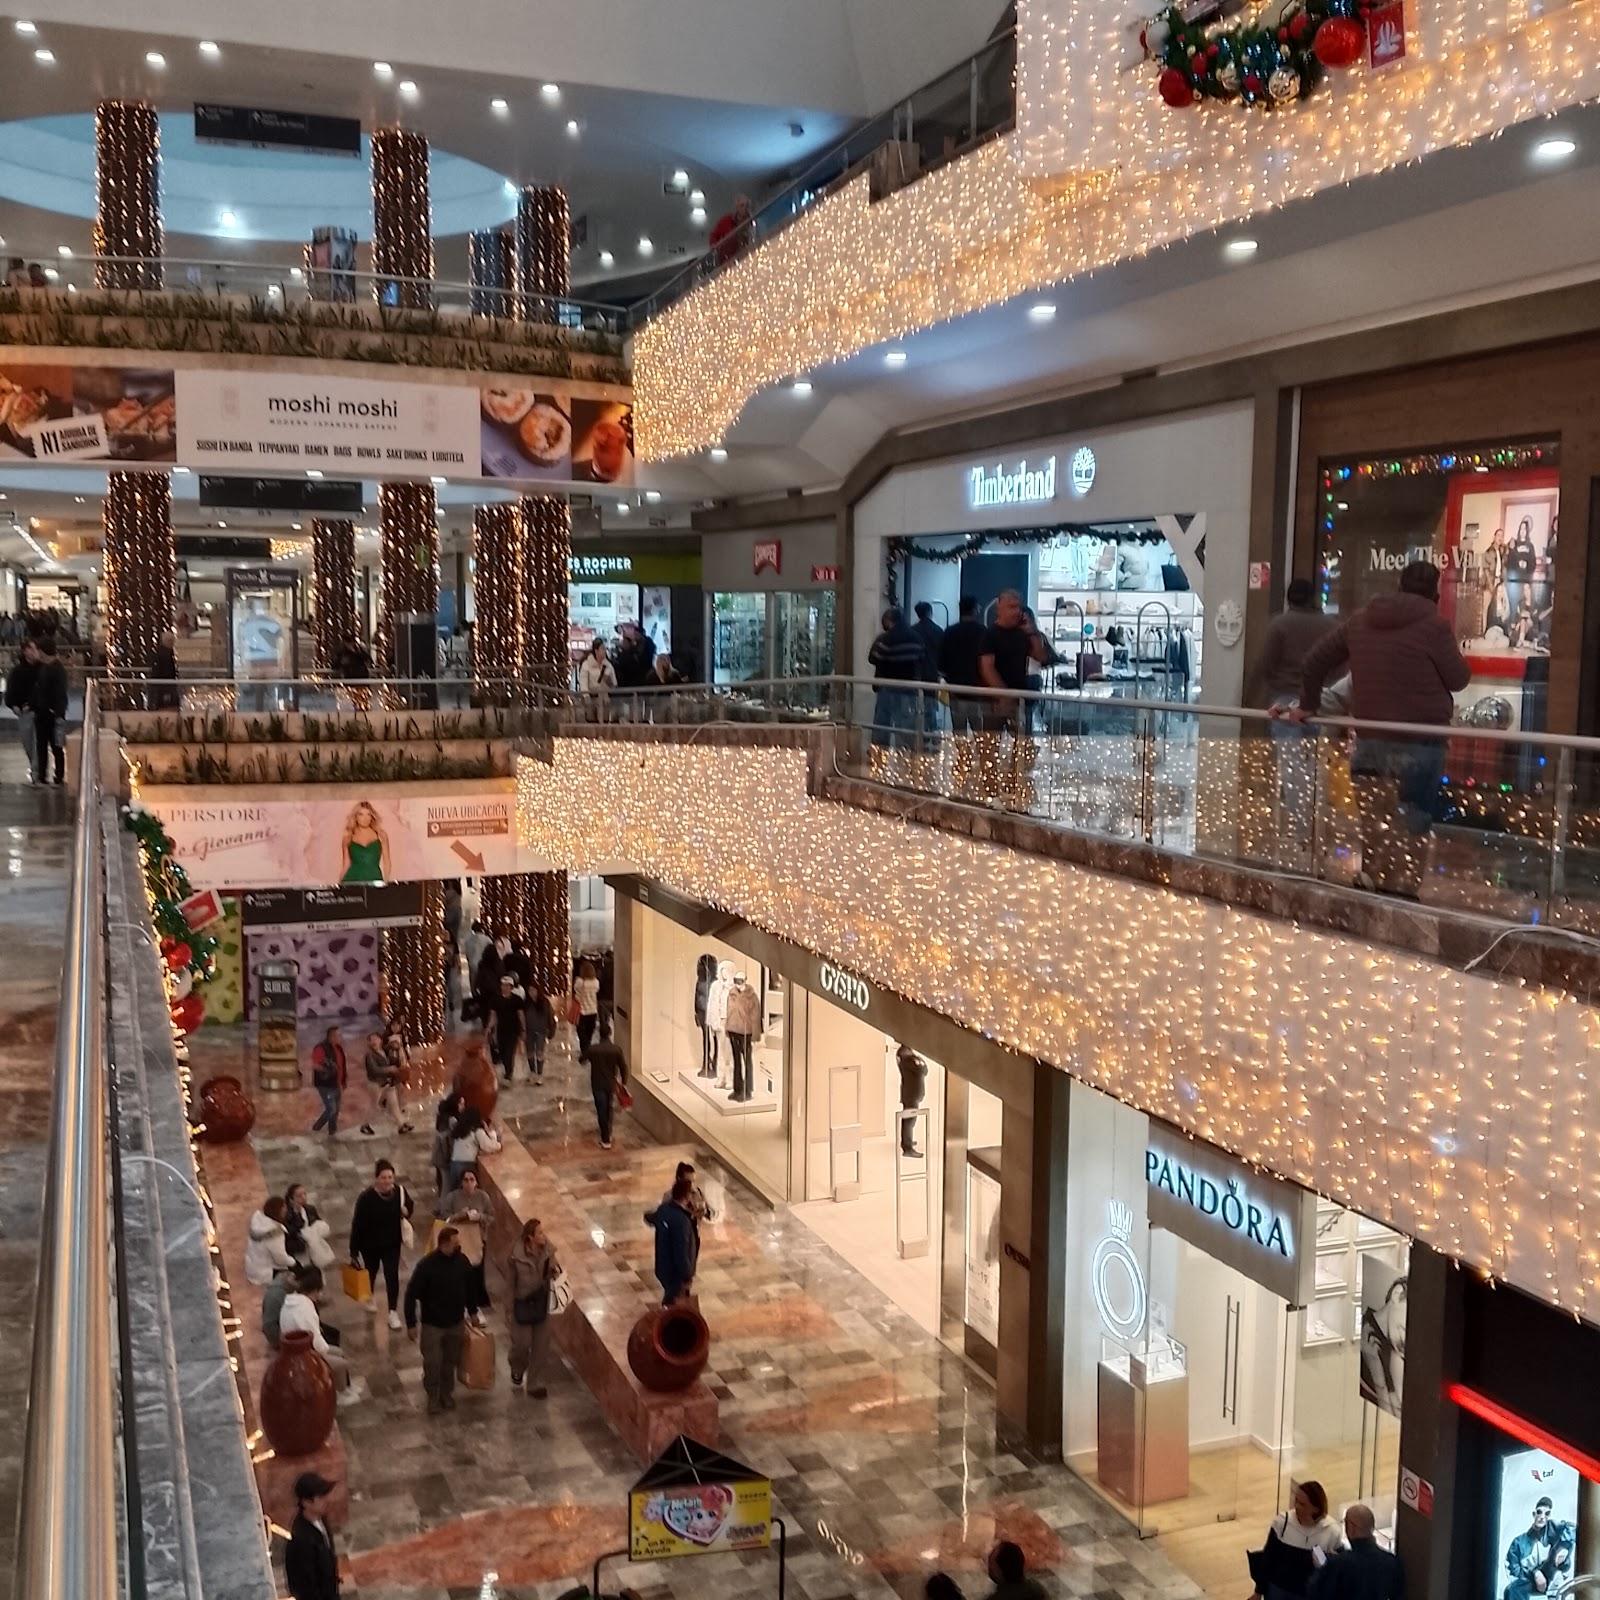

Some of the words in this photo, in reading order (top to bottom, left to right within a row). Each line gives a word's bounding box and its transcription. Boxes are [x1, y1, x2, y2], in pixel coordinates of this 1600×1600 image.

[268, 394, 330, 414] moshi
[338, 398, 398, 418] moshi
[304, 444, 328, 456] RAMEN
[357, 447, 381, 459] BOWLS
[971, 455, 1056, 506] Timberland
[583, 557, 632, 571] ROCHER
[427, 806, 459, 820] NUEVA
[460, 803, 507, 818] UBICACIÓN
[820, 962, 869, 1010] OYSHO
[1145, 1150, 1289, 1257] PANDORA
